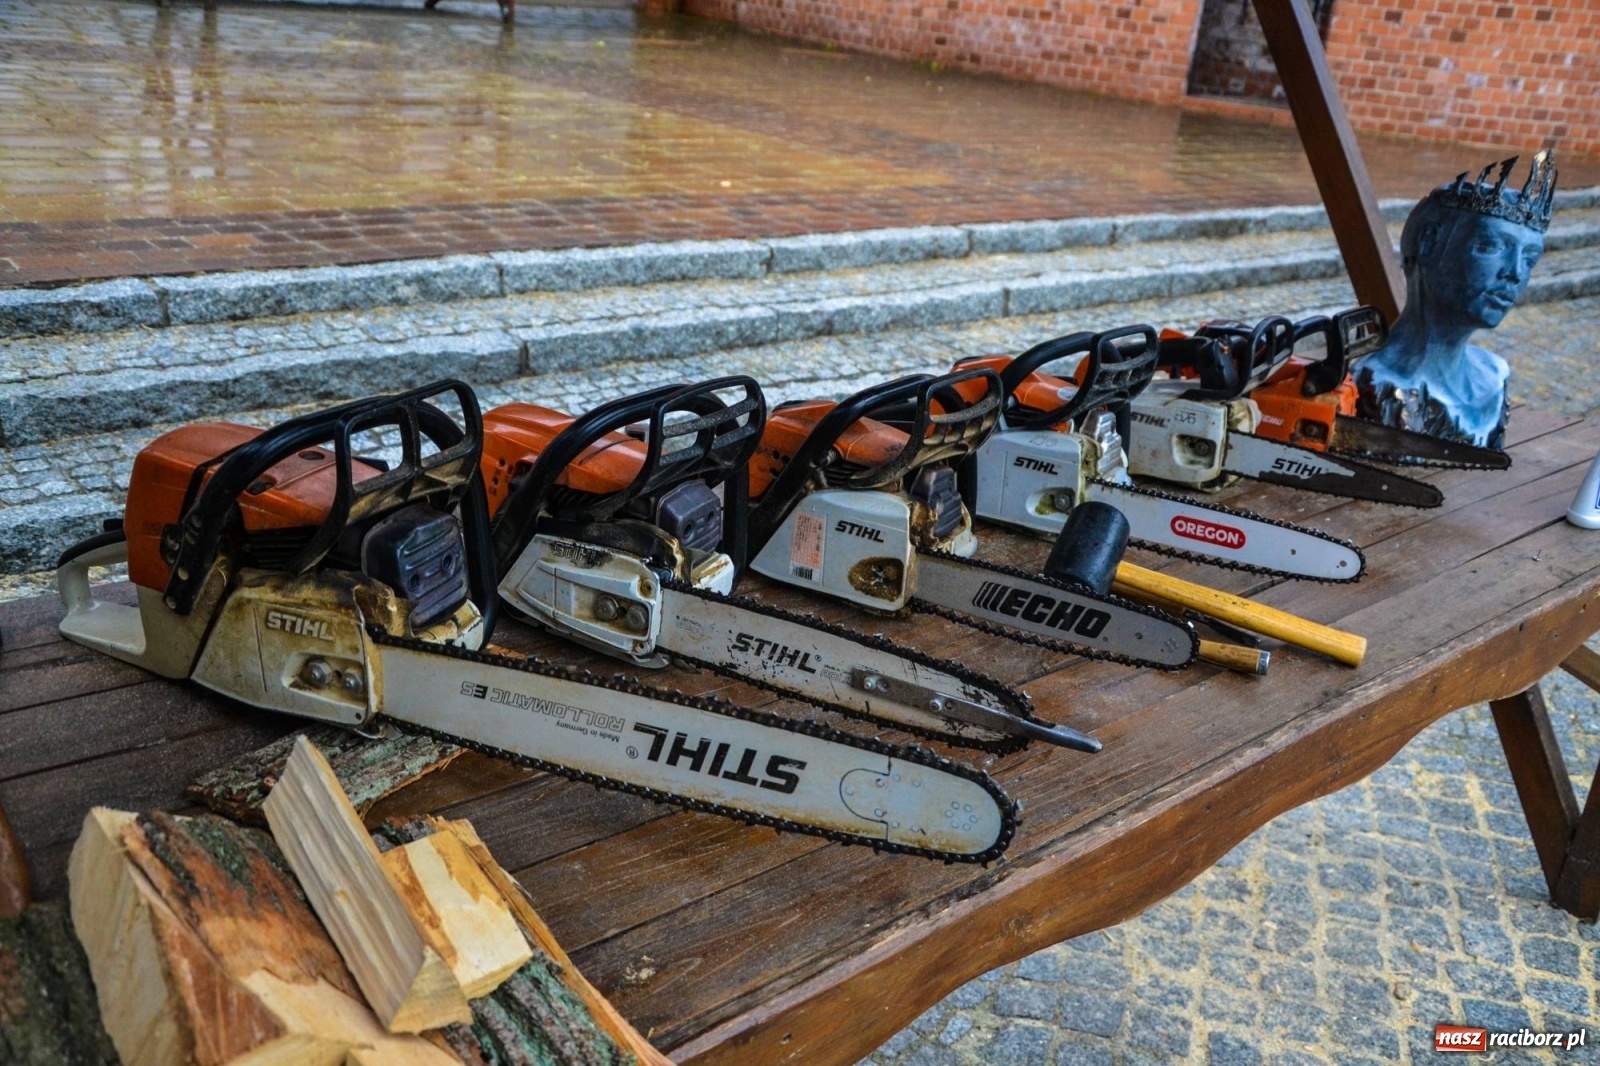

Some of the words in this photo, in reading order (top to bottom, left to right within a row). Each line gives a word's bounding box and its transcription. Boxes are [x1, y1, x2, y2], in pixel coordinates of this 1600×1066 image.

[1131, 411, 1168, 428] STIHL
[1013, 456, 1059, 475] STIHL
[835, 519, 885, 543] STIHL
[1174, 520, 1239, 545] OREGON
[999, 588, 1112, 638] ECHO
[266, 610, 335, 641] STIHL
[731, 632, 816, 674] STIHL
[460, 680, 489, 700] ES
[490, 687, 626, 733] ROLLOMATIC
[555, 720, 589, 735] Germany
[599, 731, 620, 743] Made
[633, 722, 807, 794] STIHL
